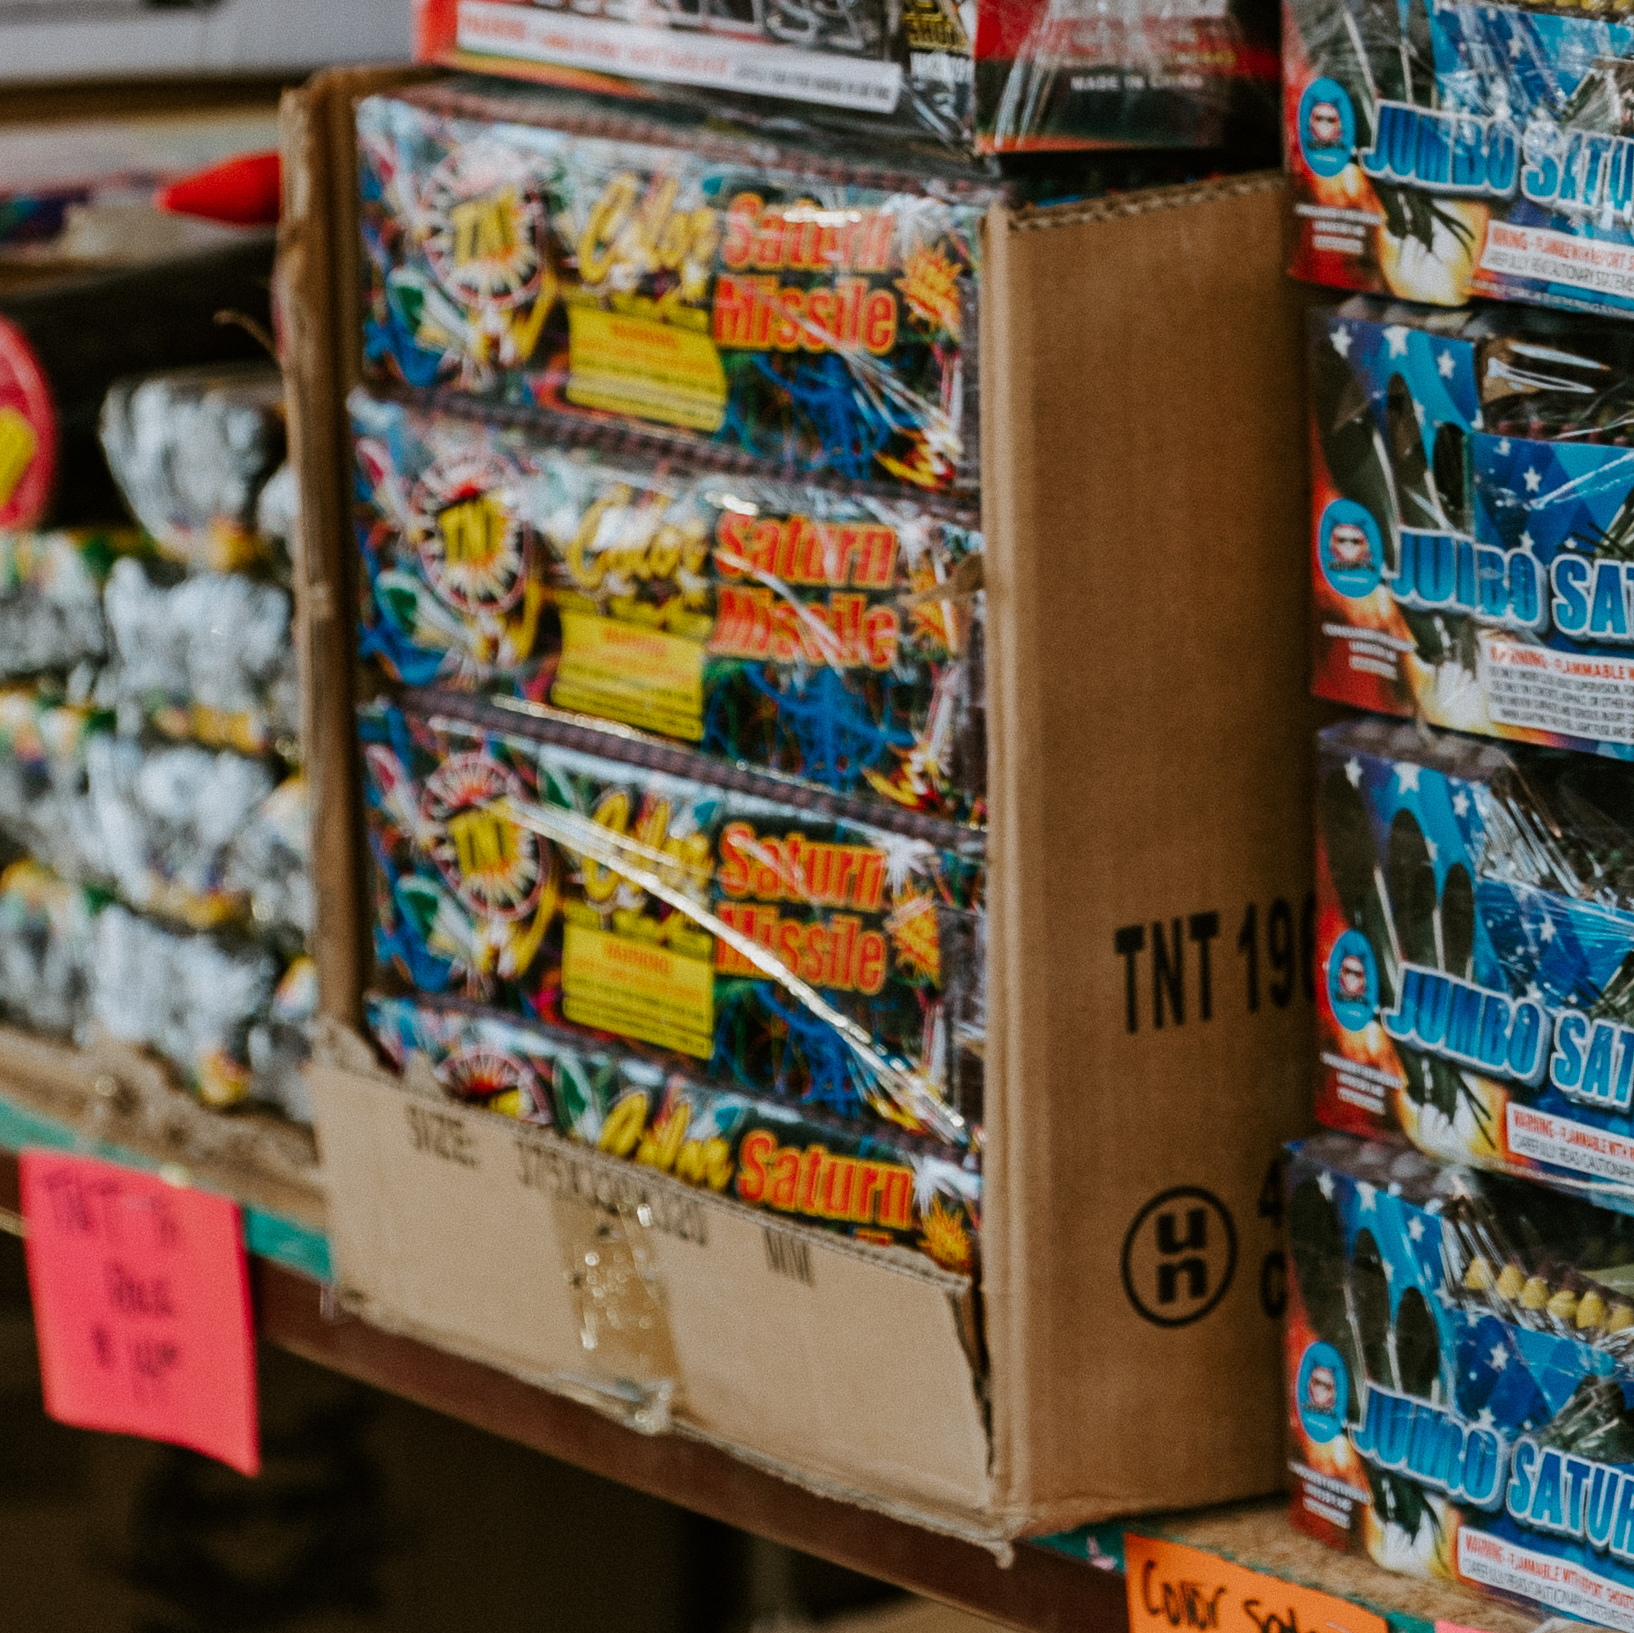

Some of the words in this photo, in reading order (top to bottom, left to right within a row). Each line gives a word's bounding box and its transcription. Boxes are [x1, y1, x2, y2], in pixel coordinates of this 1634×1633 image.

[1361, 99, 1520, 199] JUMBO
[722, 193, 898, 275] Saturn
[712, 273, 897, 356] Missile
[714, 509, 897, 588] Saturn
[711, 584, 897, 671] Missile
[719, 822, 891, 912] Saturn
[1112, 910, 1221, 1035] TNT
[1382, 960, 1550, 1087] JUMBO
[736, 1128, 915, 1231] Saturn
